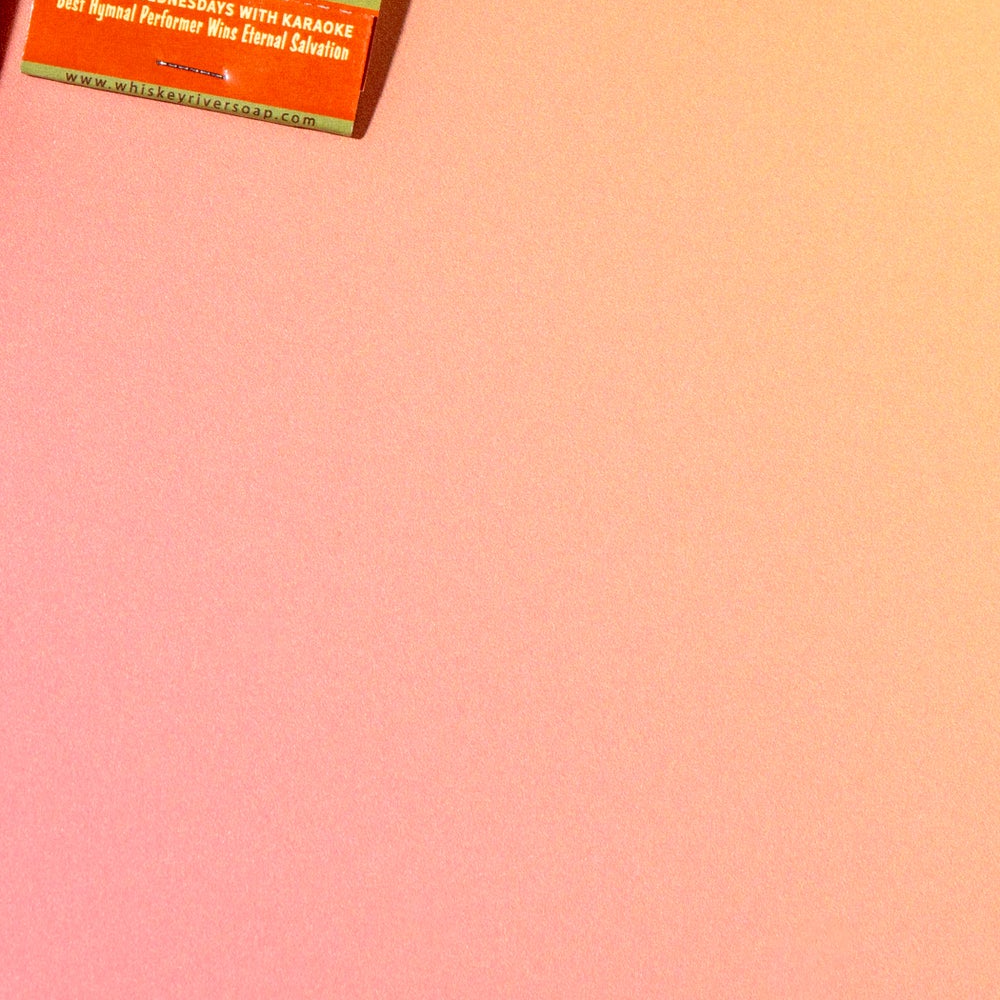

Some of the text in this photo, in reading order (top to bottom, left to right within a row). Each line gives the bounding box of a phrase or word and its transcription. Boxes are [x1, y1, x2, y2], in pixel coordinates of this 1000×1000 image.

[139, 6, 203, 34] Performer
[207, 19, 237, 40] Wins
[241, 24, 288, 50] Eternal
[290, 33, 349, 61] Salvation
[240, 7, 278, 24] WITH
[282, 14, 354, 38] KARAOKE
[65, 72, 316, 127] www.whiskeyriversoap.com
